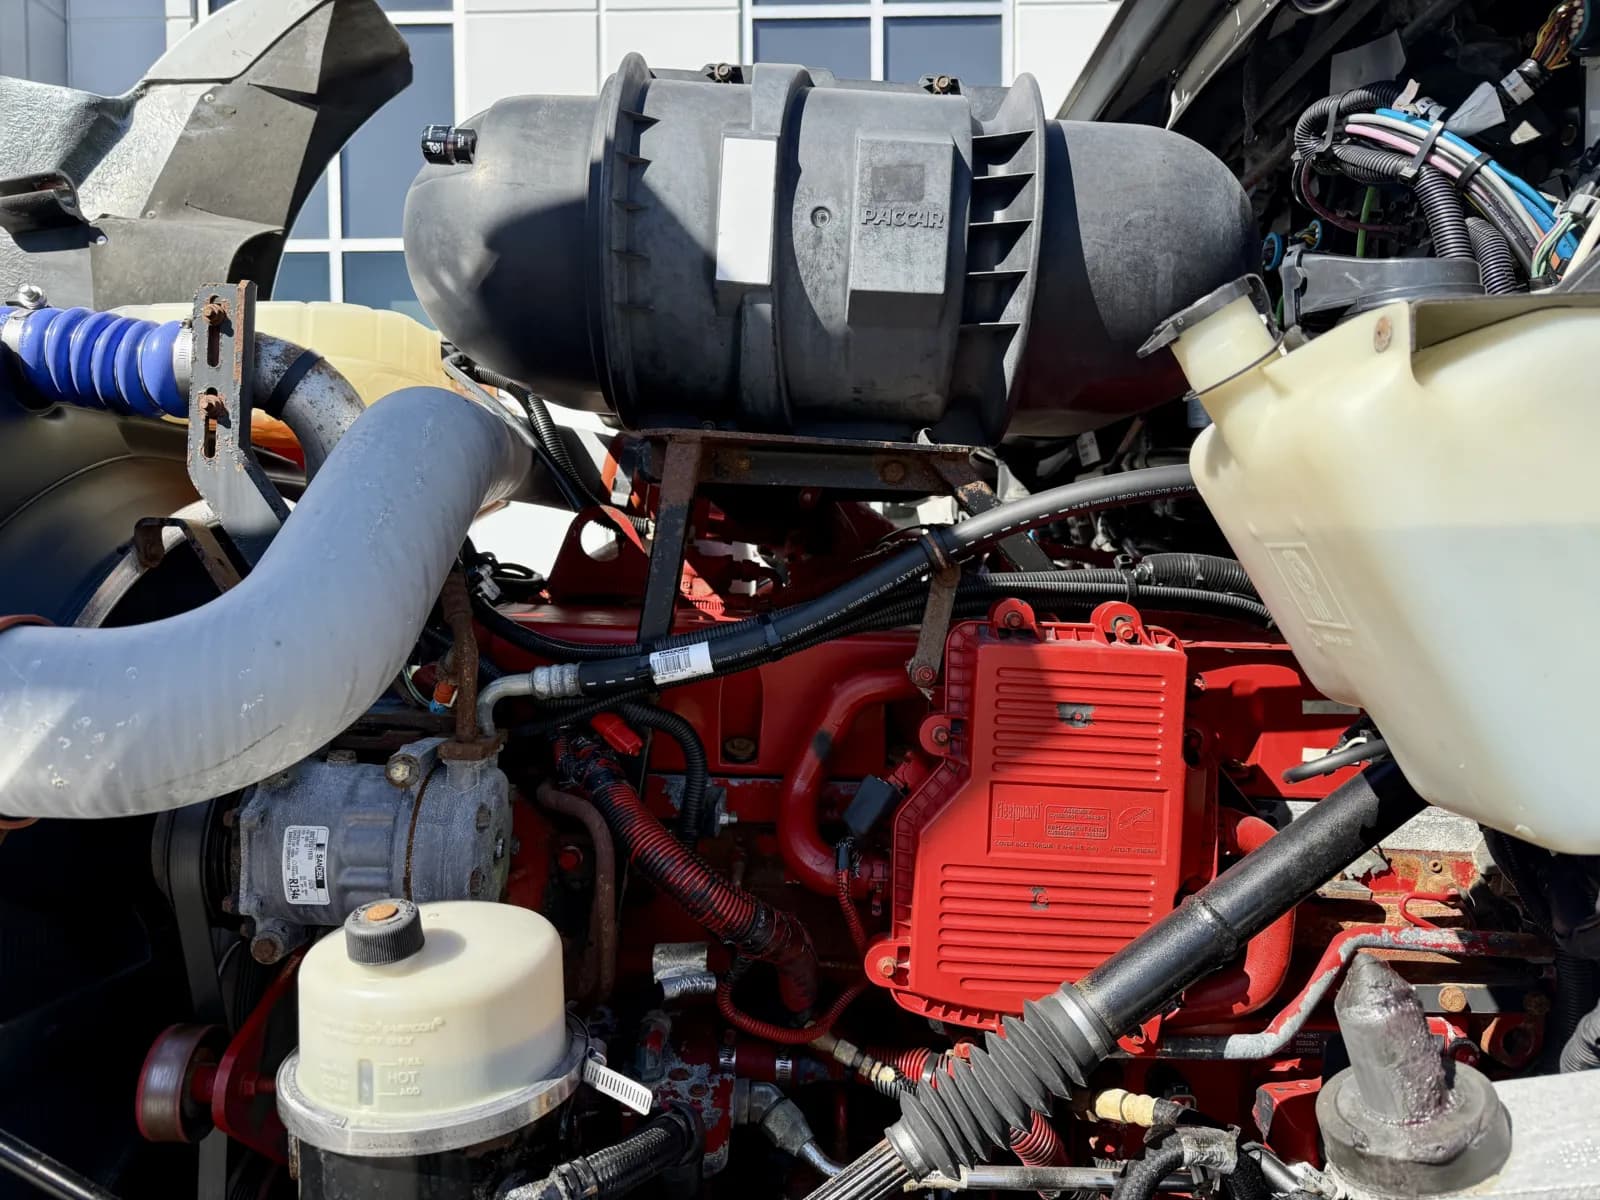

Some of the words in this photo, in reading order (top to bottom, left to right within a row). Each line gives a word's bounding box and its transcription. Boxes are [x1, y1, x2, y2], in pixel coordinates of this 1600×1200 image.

[862, 207, 944, 228] PACCAR
[1116, 491, 1138, 501] HOSE
[1138, 487, 1172, 497] SUCTION
[894, 561, 930, 585] GALAXY
[316, 854, 324, 880] SANDEN
[387, 1070, 418, 1084] HOT
[399, 1087, 421, 1096] ADD
